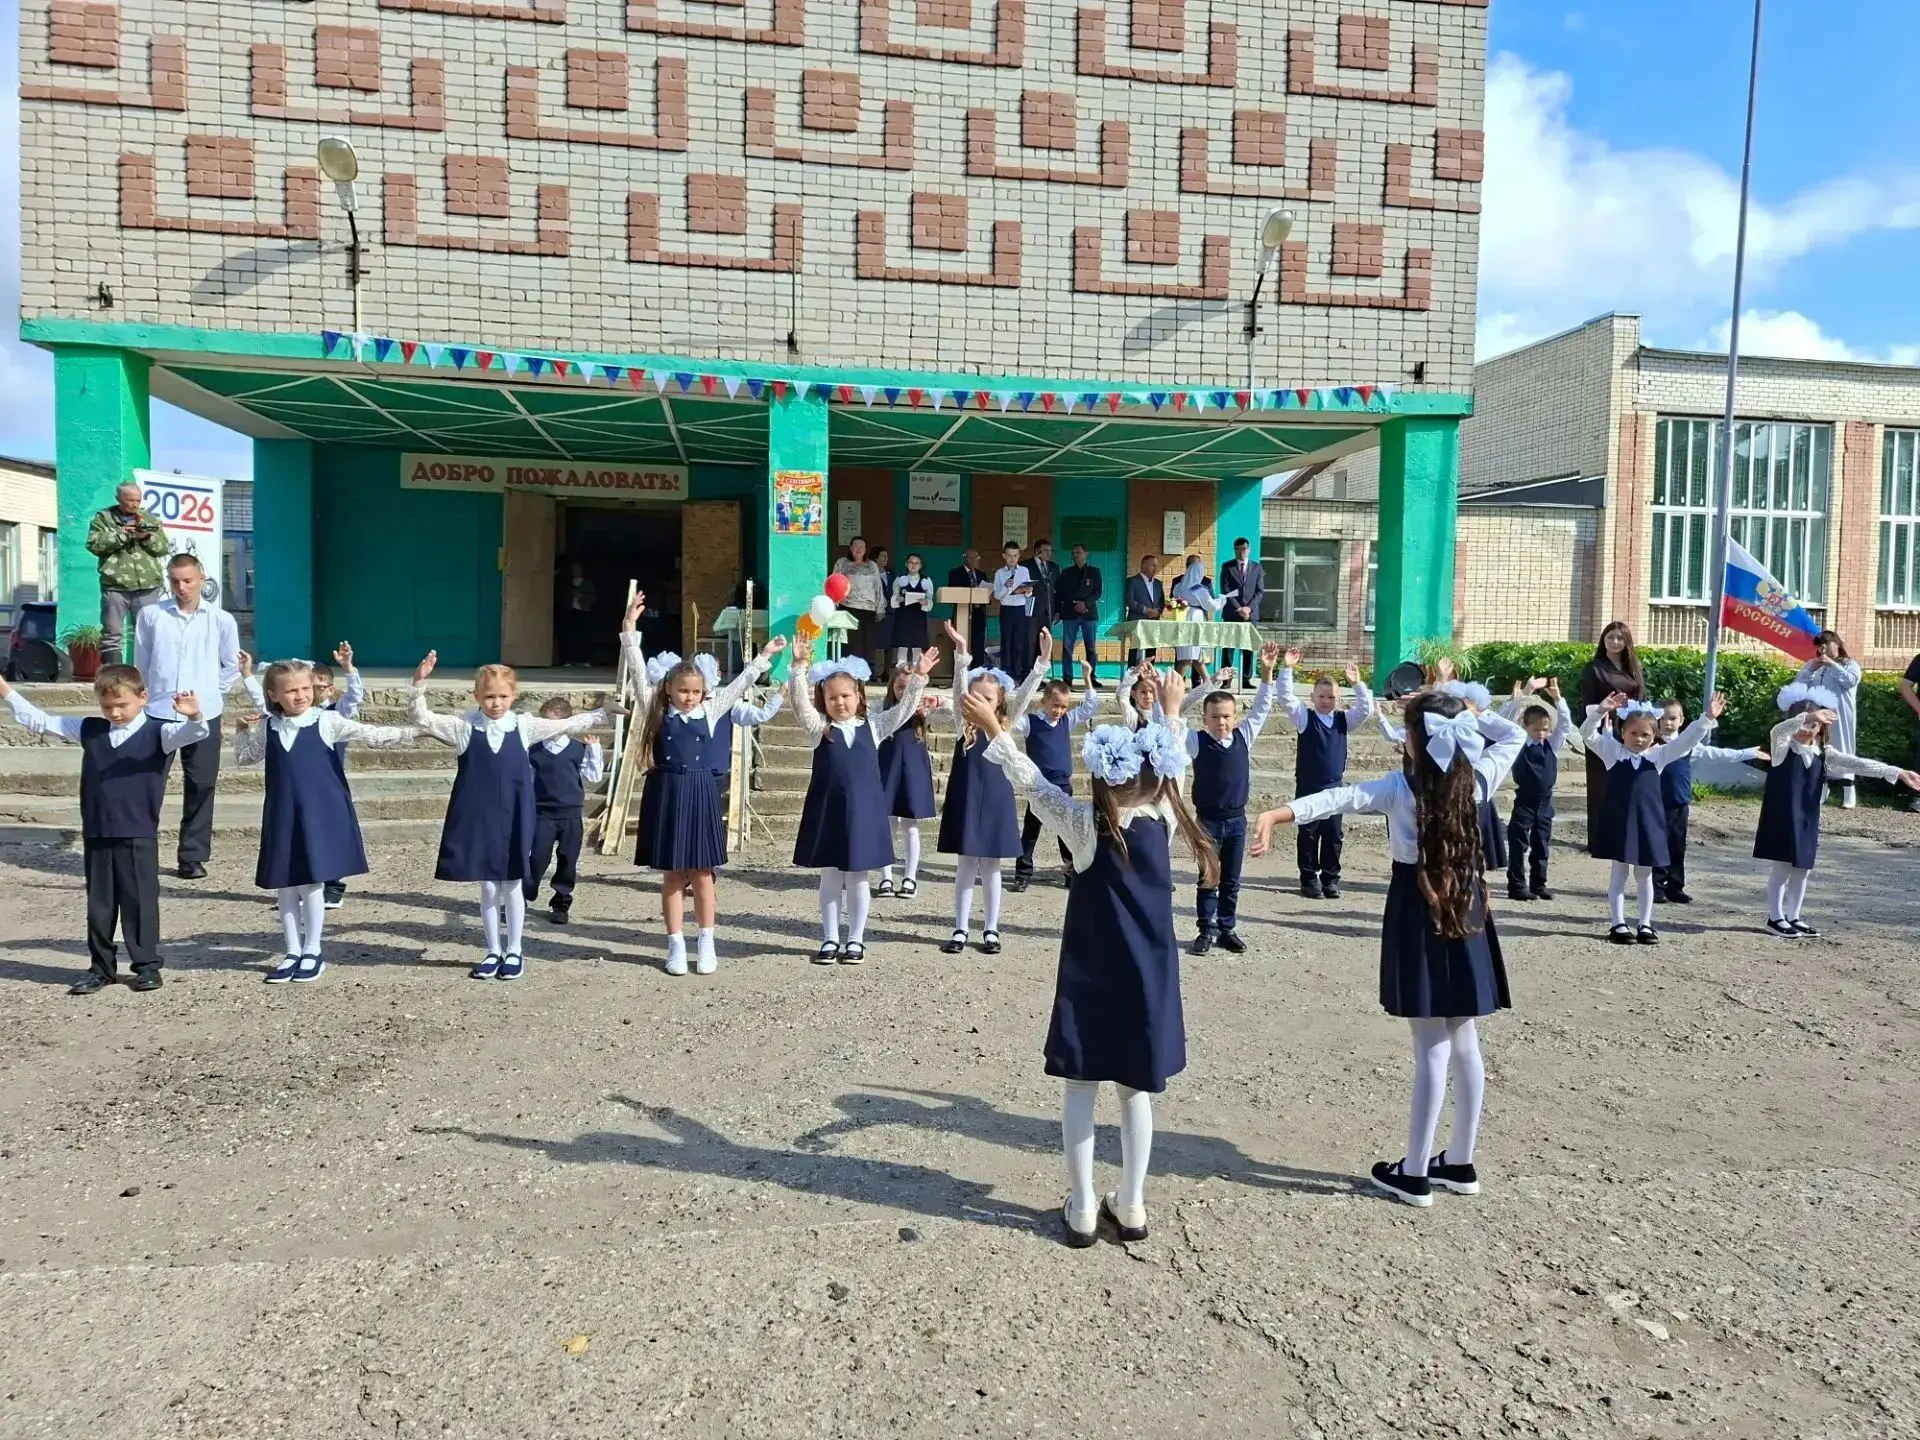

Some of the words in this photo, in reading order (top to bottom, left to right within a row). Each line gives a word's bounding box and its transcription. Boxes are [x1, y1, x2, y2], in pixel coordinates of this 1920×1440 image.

[411, 462, 495, 483] ДОБРО
[506, 466, 680, 491] ПОЖАЛОВАТЬ!
[143, 489, 214, 523] 2026
[1734, 604, 1792, 638] РОССИЯ
